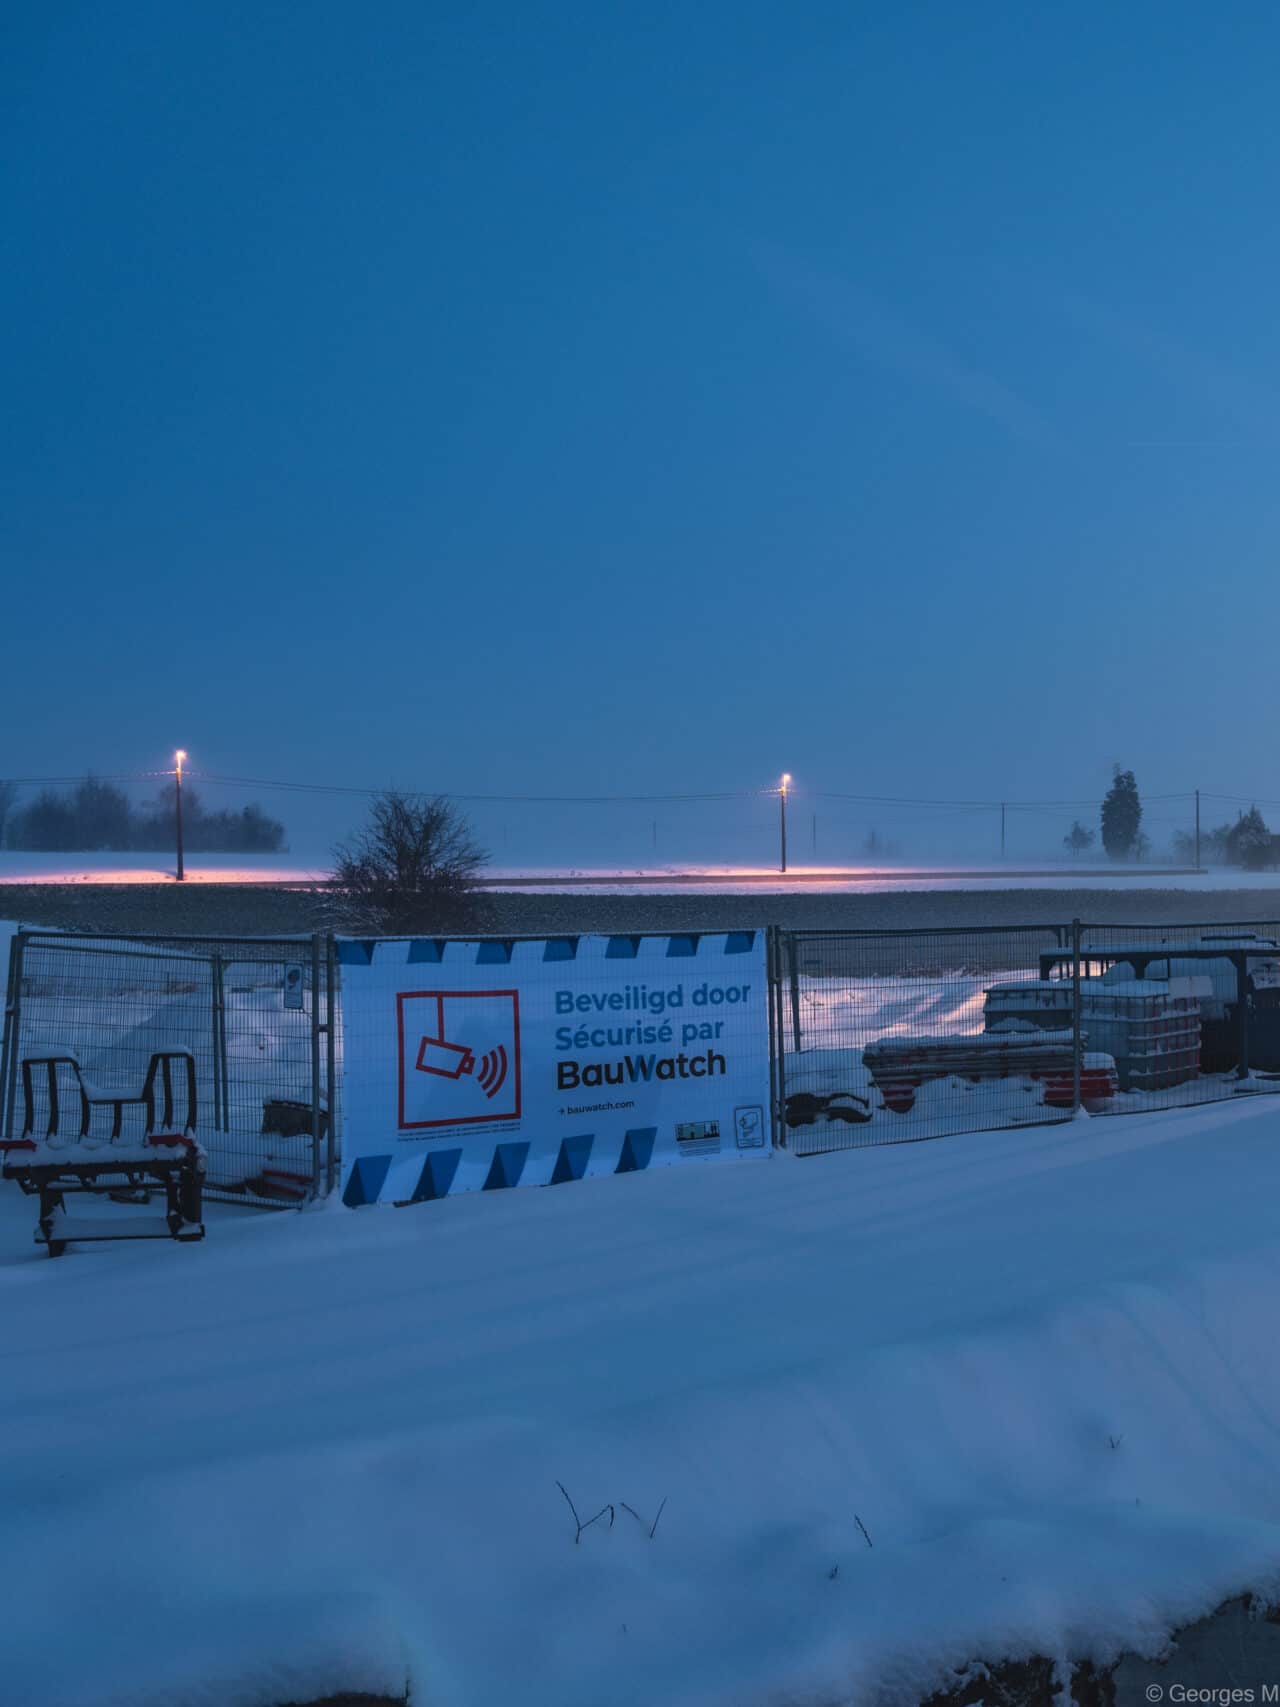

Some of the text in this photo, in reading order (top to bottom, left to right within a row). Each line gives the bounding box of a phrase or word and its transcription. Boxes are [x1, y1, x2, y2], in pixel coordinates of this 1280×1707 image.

[555, 983, 751, 1015] Beveiligd door
[555, 1018, 725, 1051] Sécurisé par
[557, 1049, 726, 1090] BauWatch
[567, 1100, 635, 1115] bauwatch.com
